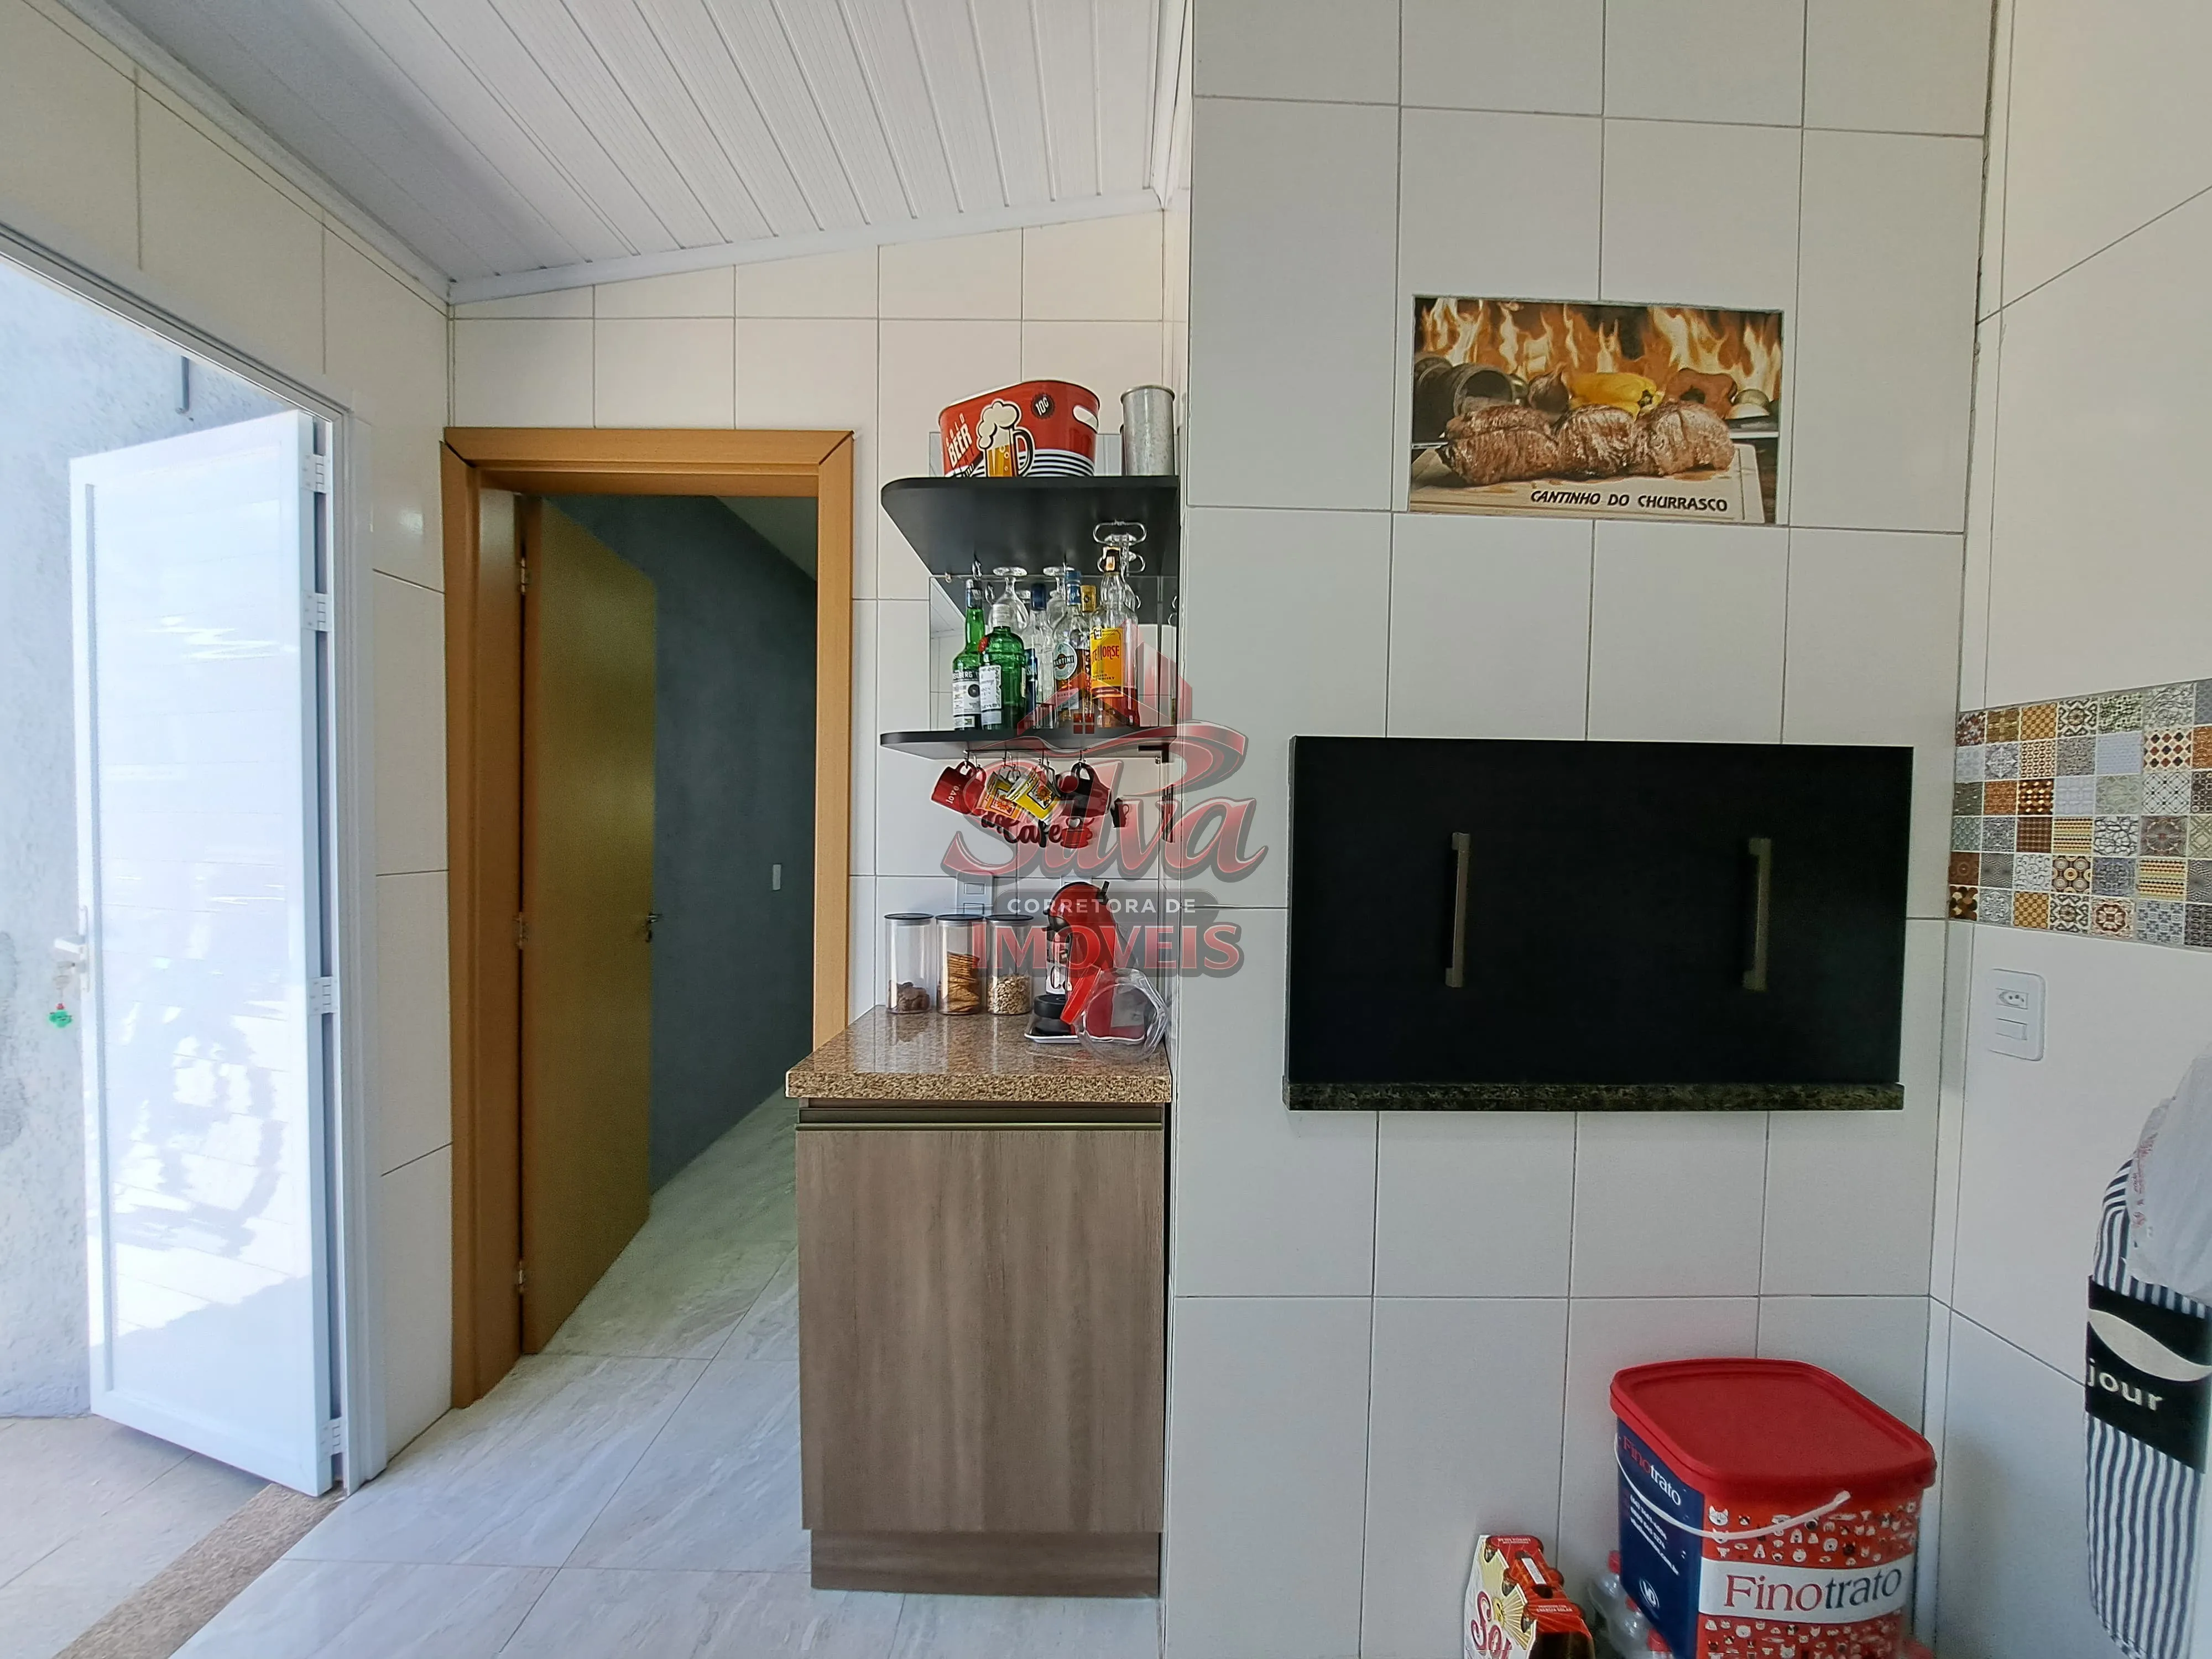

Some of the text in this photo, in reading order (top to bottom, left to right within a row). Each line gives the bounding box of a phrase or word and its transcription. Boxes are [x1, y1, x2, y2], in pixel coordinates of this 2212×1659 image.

[948, 423, 973, 469] BEER
[1531, 490, 1728, 512] CANTINHO DO CHURRASCO
[2088, 1358, 2163, 1411] jour
[1623, 1435, 1682, 1506] Finotrato
[1724, 1568, 1902, 1611] Finotrato
